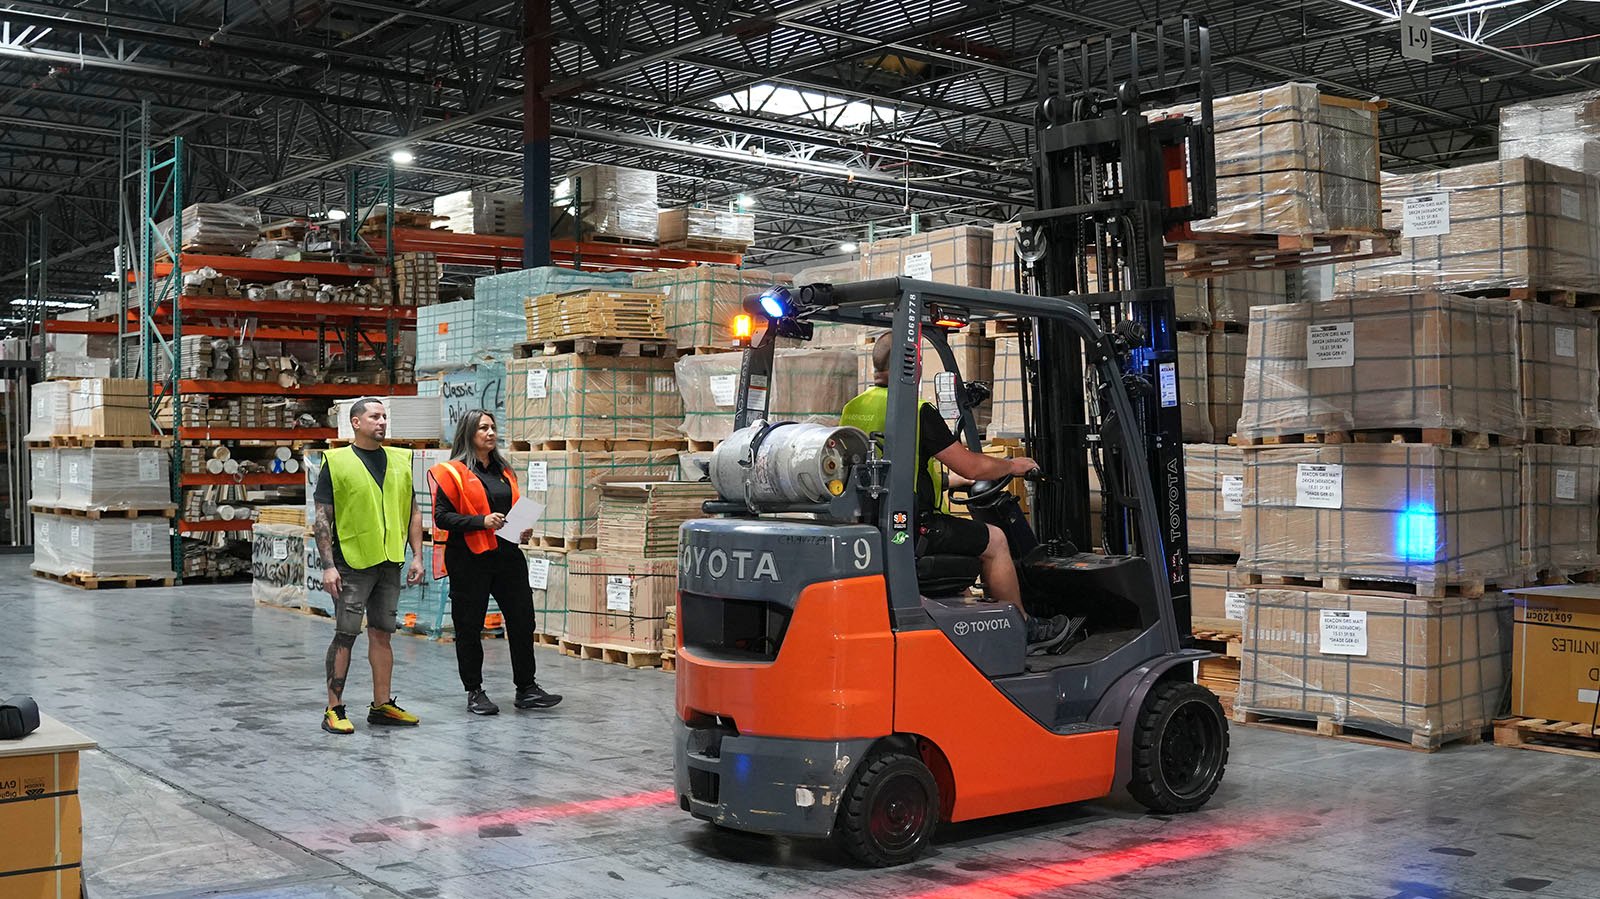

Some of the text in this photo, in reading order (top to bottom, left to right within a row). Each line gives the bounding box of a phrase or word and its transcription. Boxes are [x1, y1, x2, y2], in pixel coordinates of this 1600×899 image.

[1408, 25, 1428, 49] I-9
[442, 382, 474, 399] Classic
[1167, 458, 1181, 542] TOYOTA
[679, 544, 783, 583] TOYOTA
[853, 538, 871, 570] 9
[970, 618, 1011, 632] TOYOTA
[1552, 637, 1600, 655] INTILES
